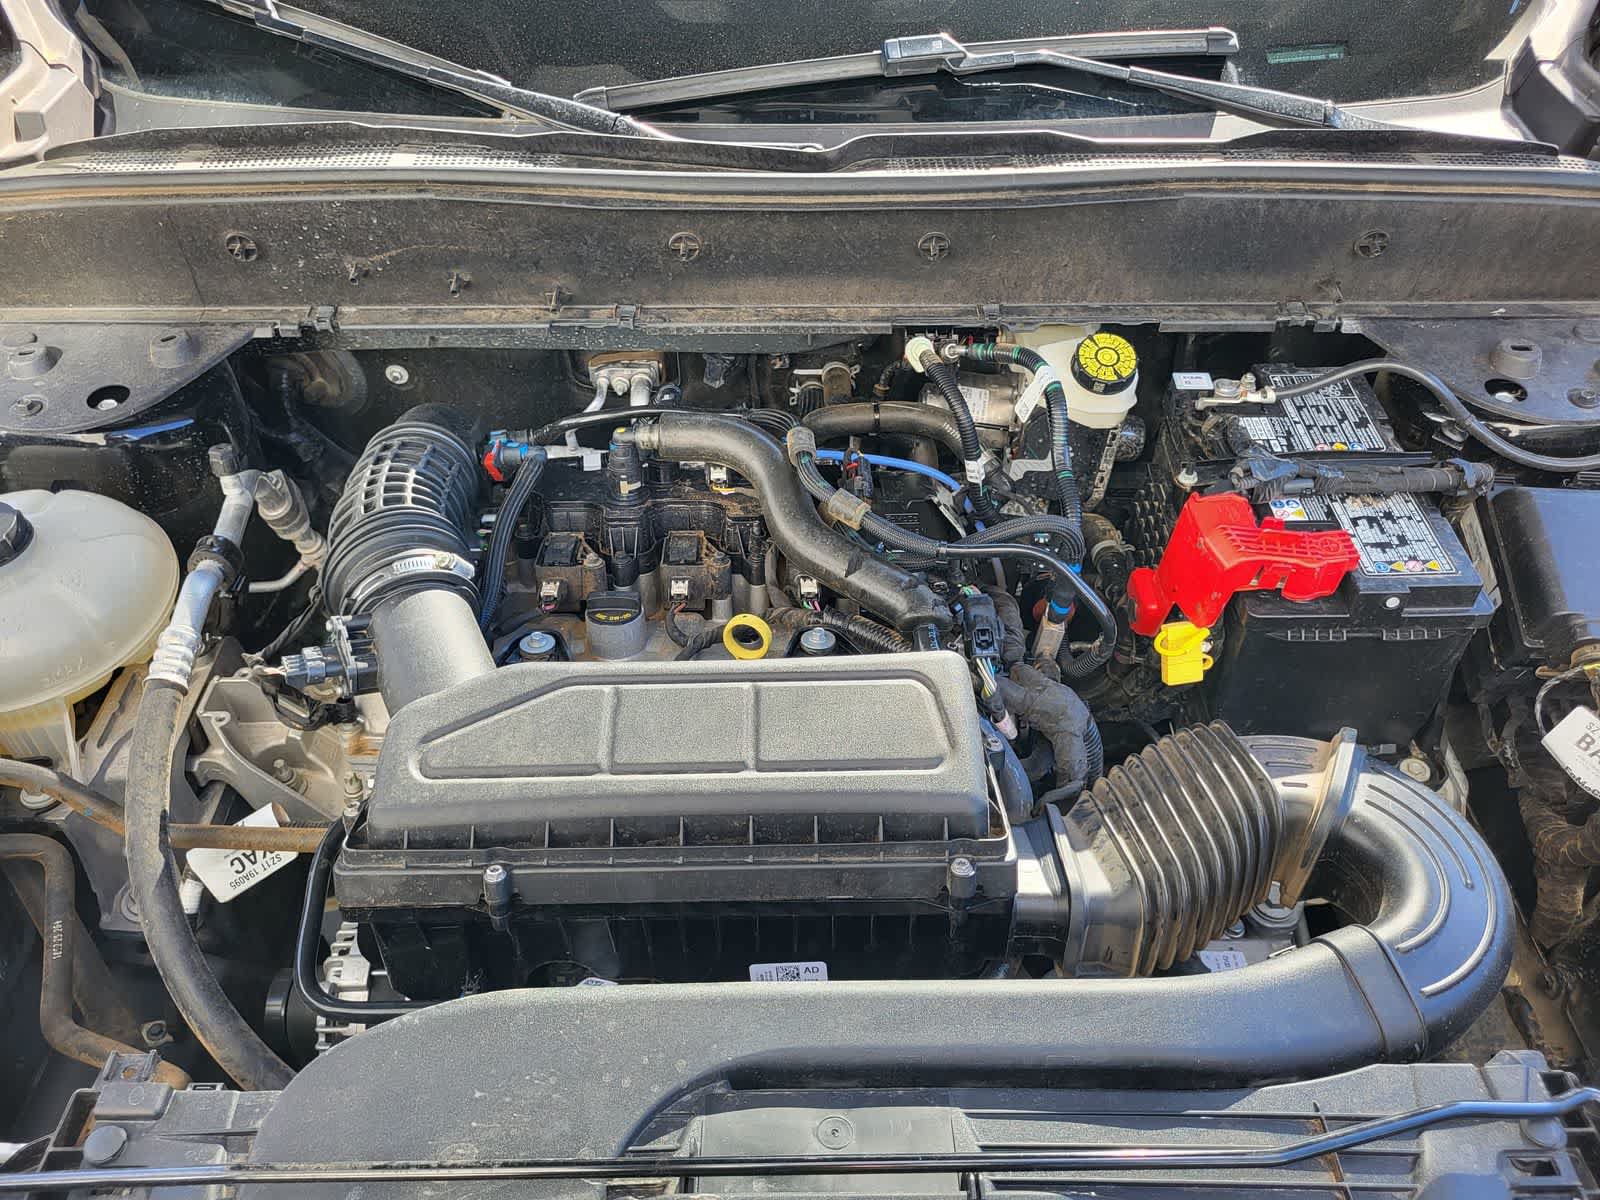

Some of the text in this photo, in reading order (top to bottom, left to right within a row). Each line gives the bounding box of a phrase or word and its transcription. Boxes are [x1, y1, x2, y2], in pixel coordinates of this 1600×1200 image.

[1565, 766, 1600, 798] FoMoC
[260, 853, 282, 872] SZ1T
[229, 868, 259, 890] 19A095
[804, 966, 820, 974] AD
